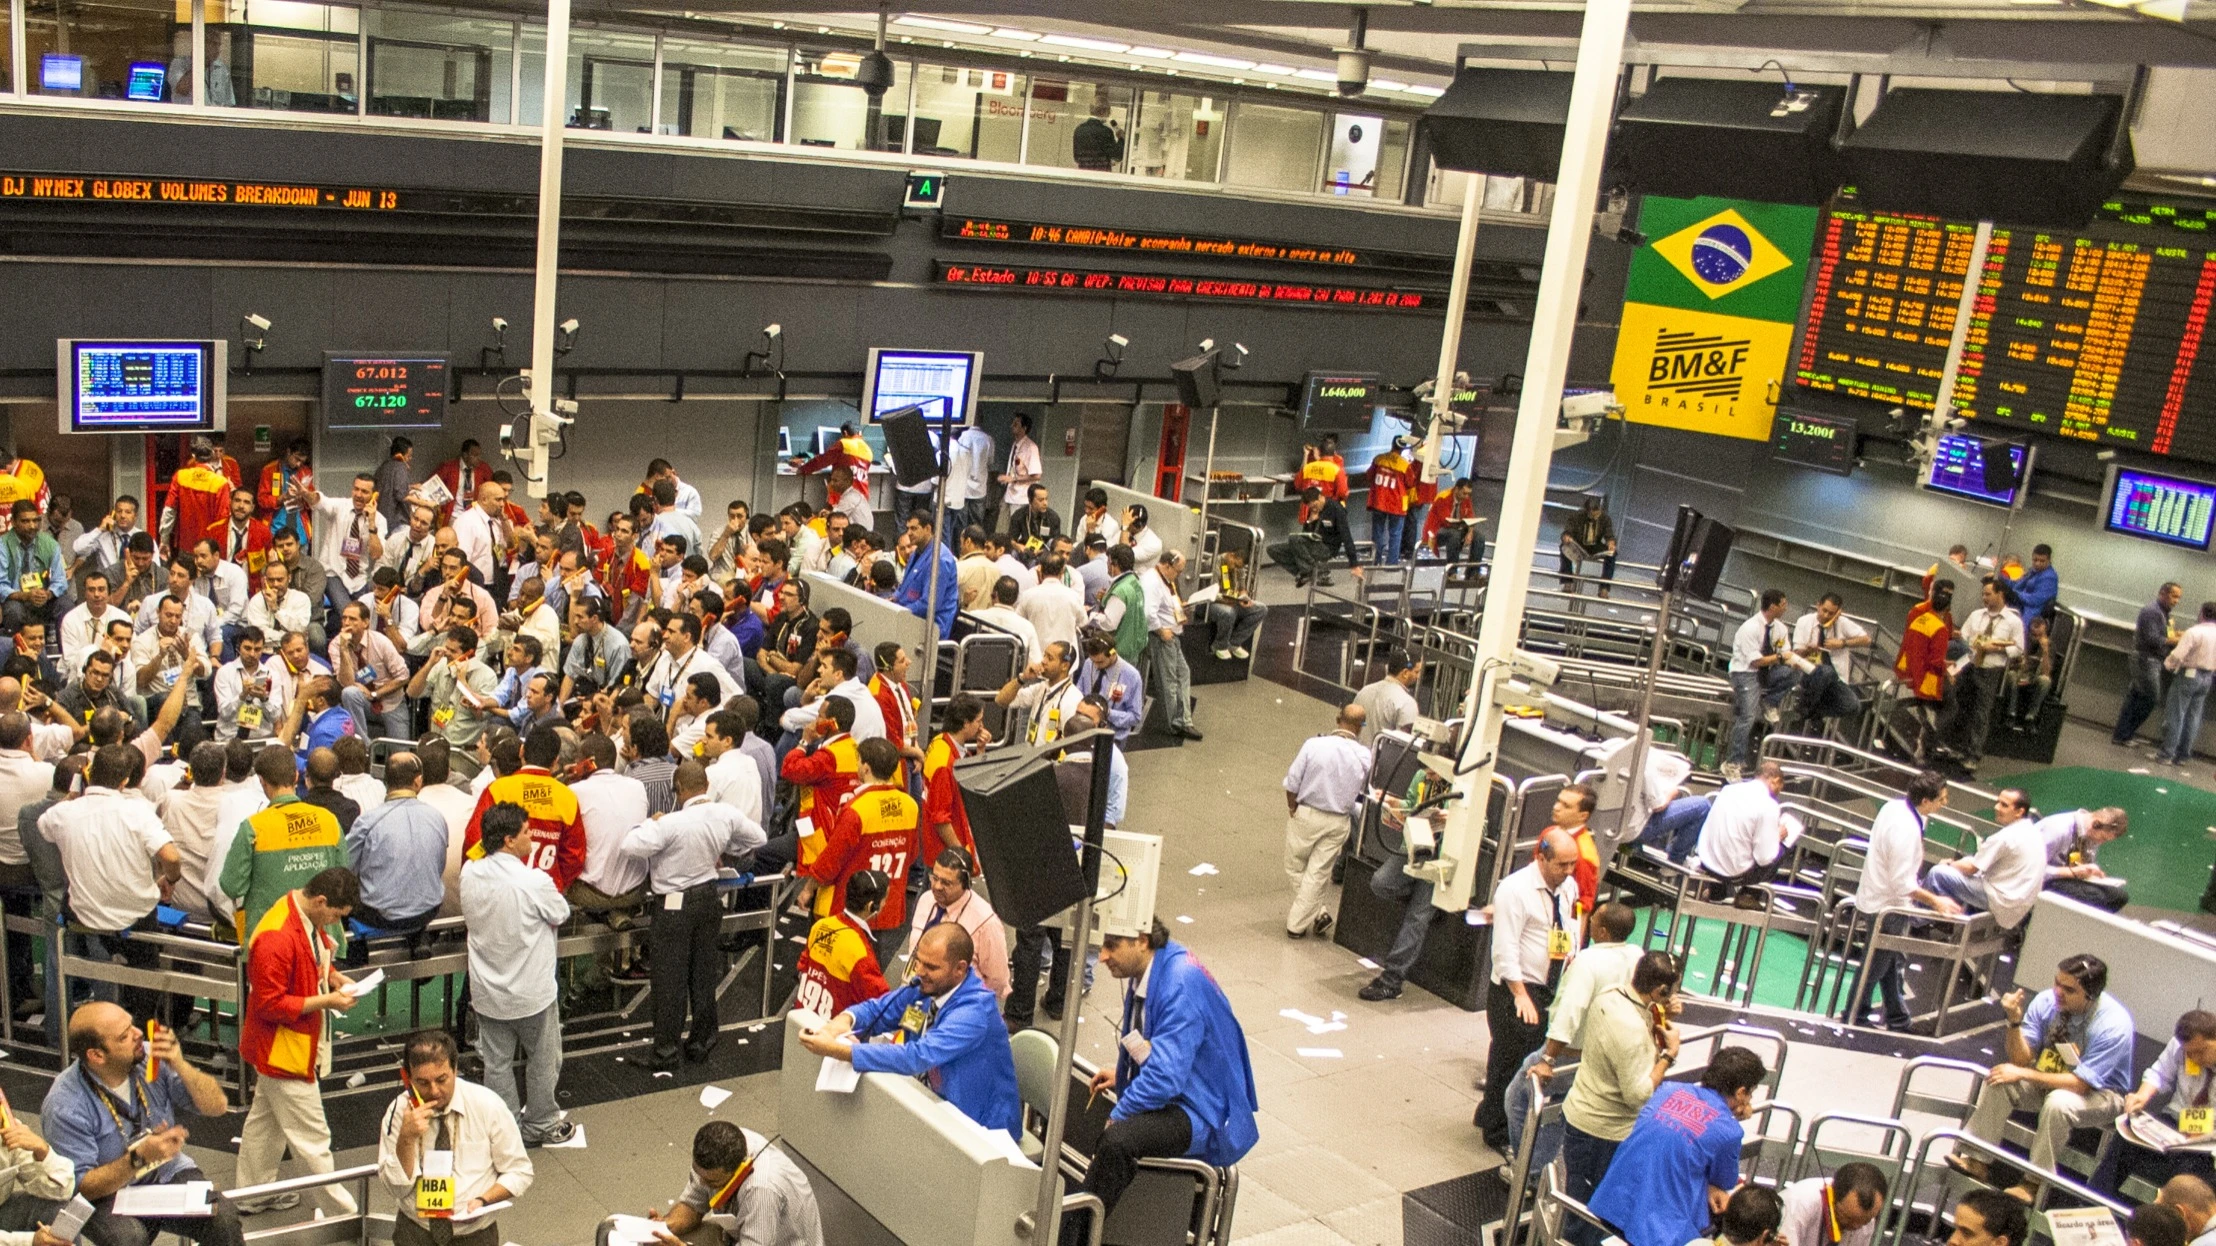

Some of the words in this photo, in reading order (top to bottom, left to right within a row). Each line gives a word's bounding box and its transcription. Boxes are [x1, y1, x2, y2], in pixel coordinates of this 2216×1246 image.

[3, 178, 24, 196] DJ
[33, 179, 84, 198] NYMEX
[93, 181, 151, 199] GLOBEX
[161, 184, 226, 202] VOLUMES
[235, 186, 317, 206] BREAKDOWN
[343, 190, 370, 208] JUN
[379, 191, 397, 209] 13
[918, 179, 931, 195] A
[1030, 226, 1061, 242] 10:46
[1649, 347, 1749, 382] BM&F
[356, 367, 407, 379] 67.012
[1319, 386, 1366, 399] 1.646,000
[355, 395, 407, 408] 67.120
[1644, 394, 1736, 417] BRASIL
[523, 787, 552, 801] BM&F
[286, 813, 318, 834] BM&F
[868, 851, 907, 879] 127
[797, 972, 834, 1020] 198
[2184, 1109, 2207, 1121] FCO
[421, 1179, 448, 1192] HBA
[426, 1198, 443, 1208] 144
